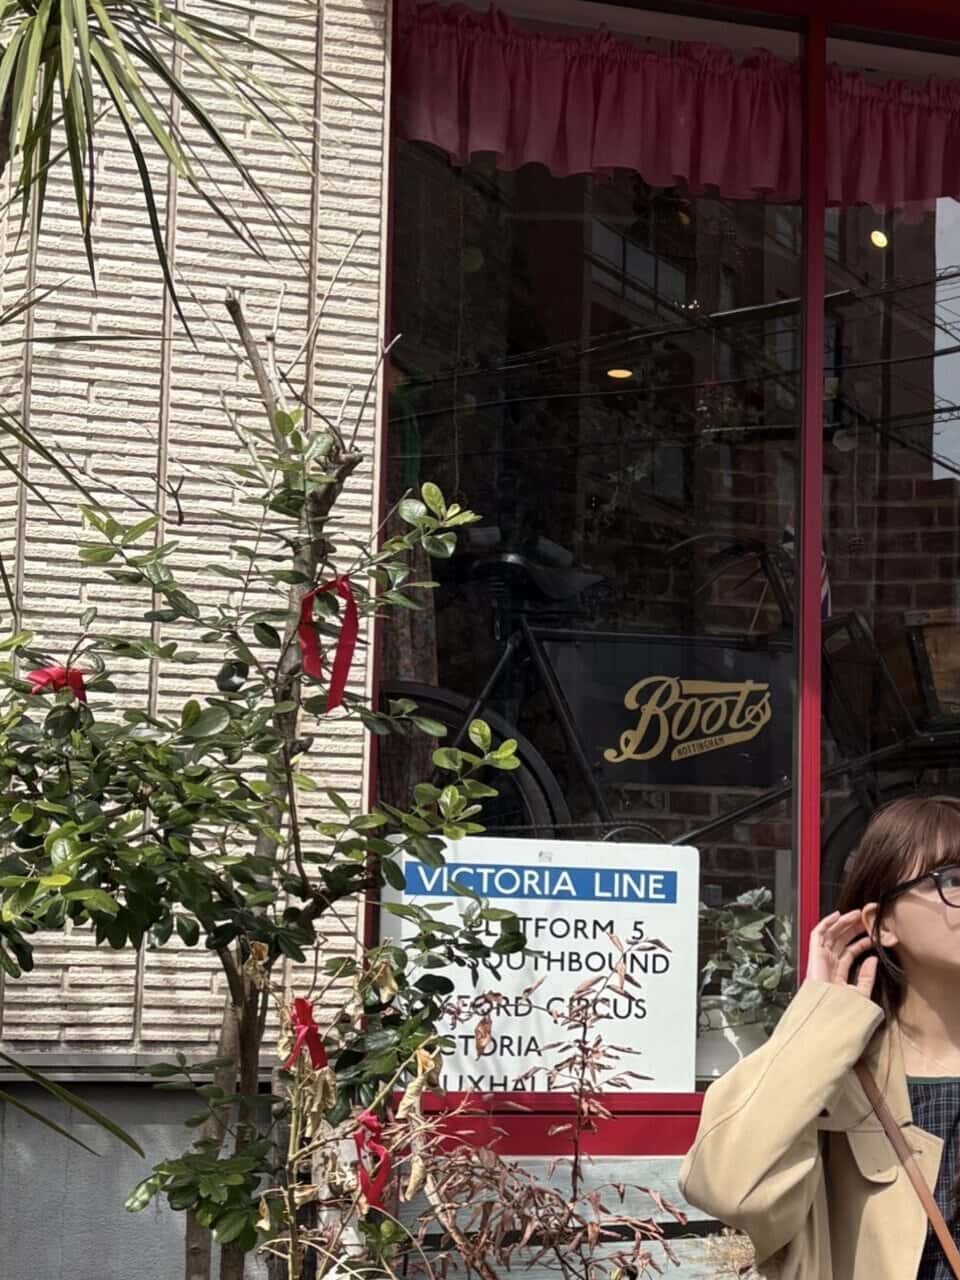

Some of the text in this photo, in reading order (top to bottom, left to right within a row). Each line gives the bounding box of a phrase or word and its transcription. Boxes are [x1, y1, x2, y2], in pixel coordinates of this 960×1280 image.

[603, 675, 772, 763] Boots
[417, 866, 667, 900] VICTORIA LINE
[467, 916, 645, 941] LTFORM 5
[434, 994, 533, 1017] XFORD
[440, 1034, 542, 1057] CTORIA
[443, 1074, 552, 1092] UXHALL
